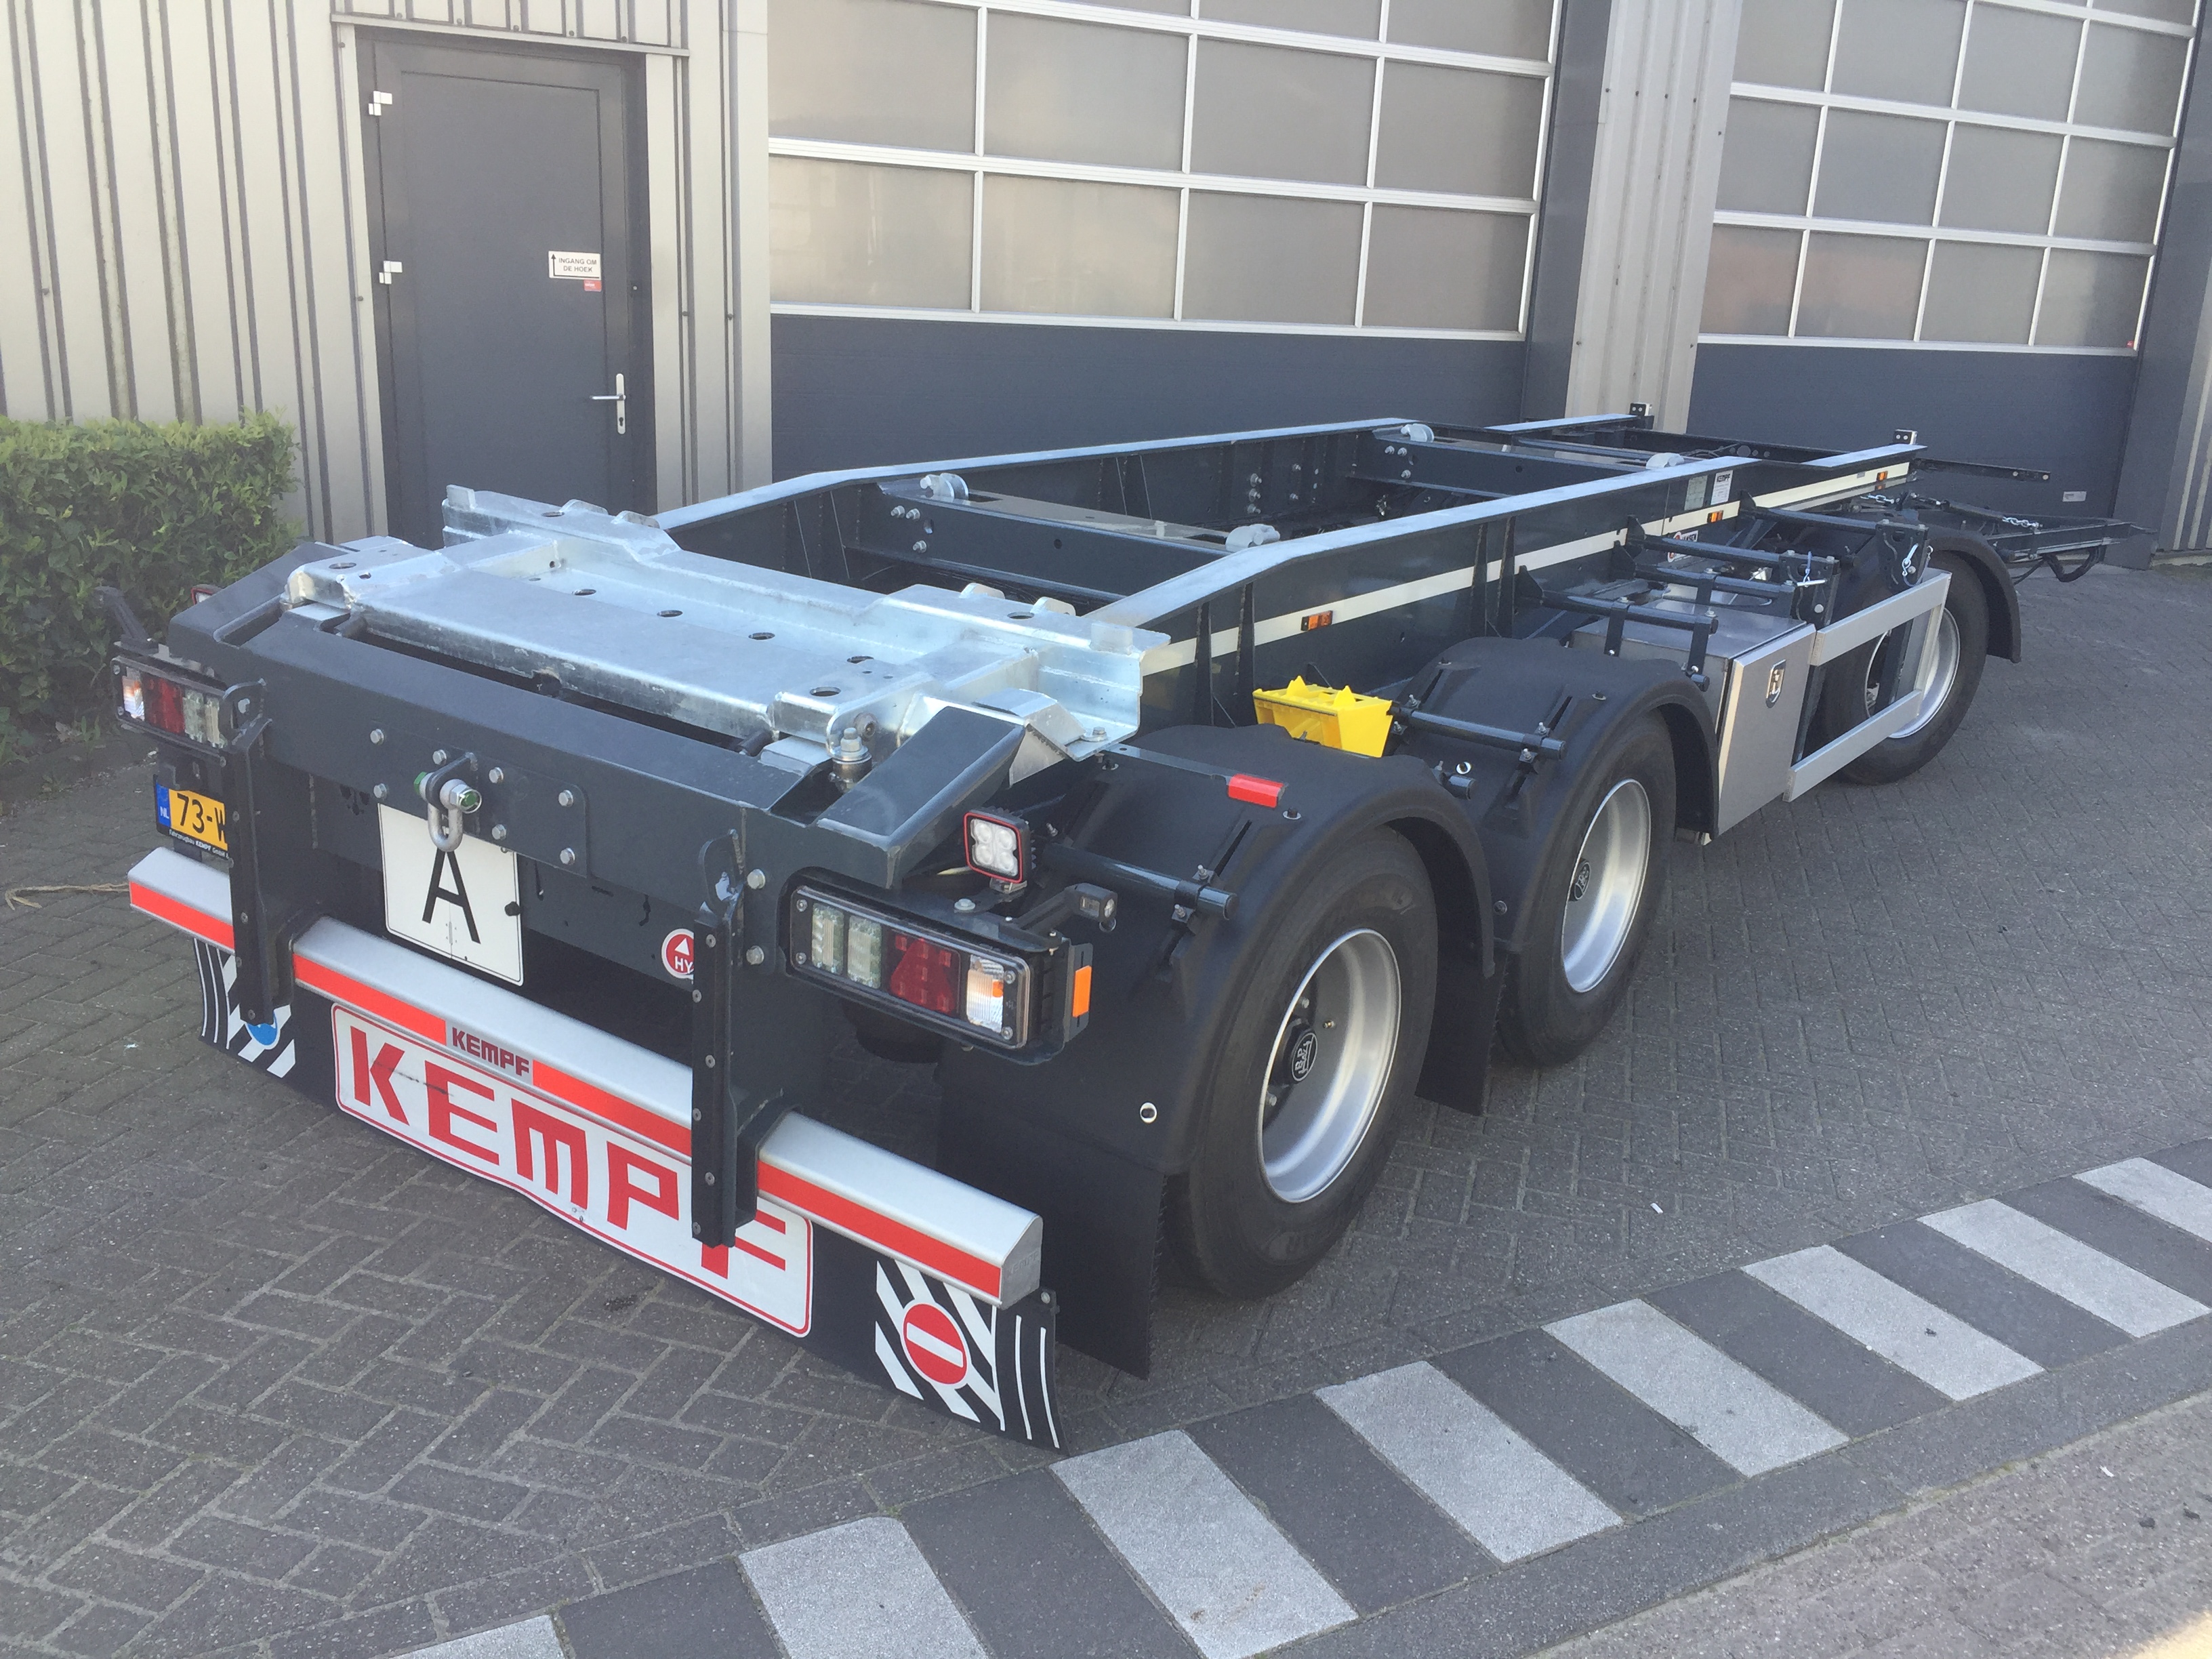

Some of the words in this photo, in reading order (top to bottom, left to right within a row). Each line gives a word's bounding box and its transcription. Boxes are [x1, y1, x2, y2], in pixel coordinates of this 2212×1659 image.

[160, 806, 169, 819] NL
[177, 792, 226, 843] 73-W
[195, 840, 211, 851] KEMPF
[422, 846, 481, 944] A
[452, 1027, 529, 1076] KEMPF
